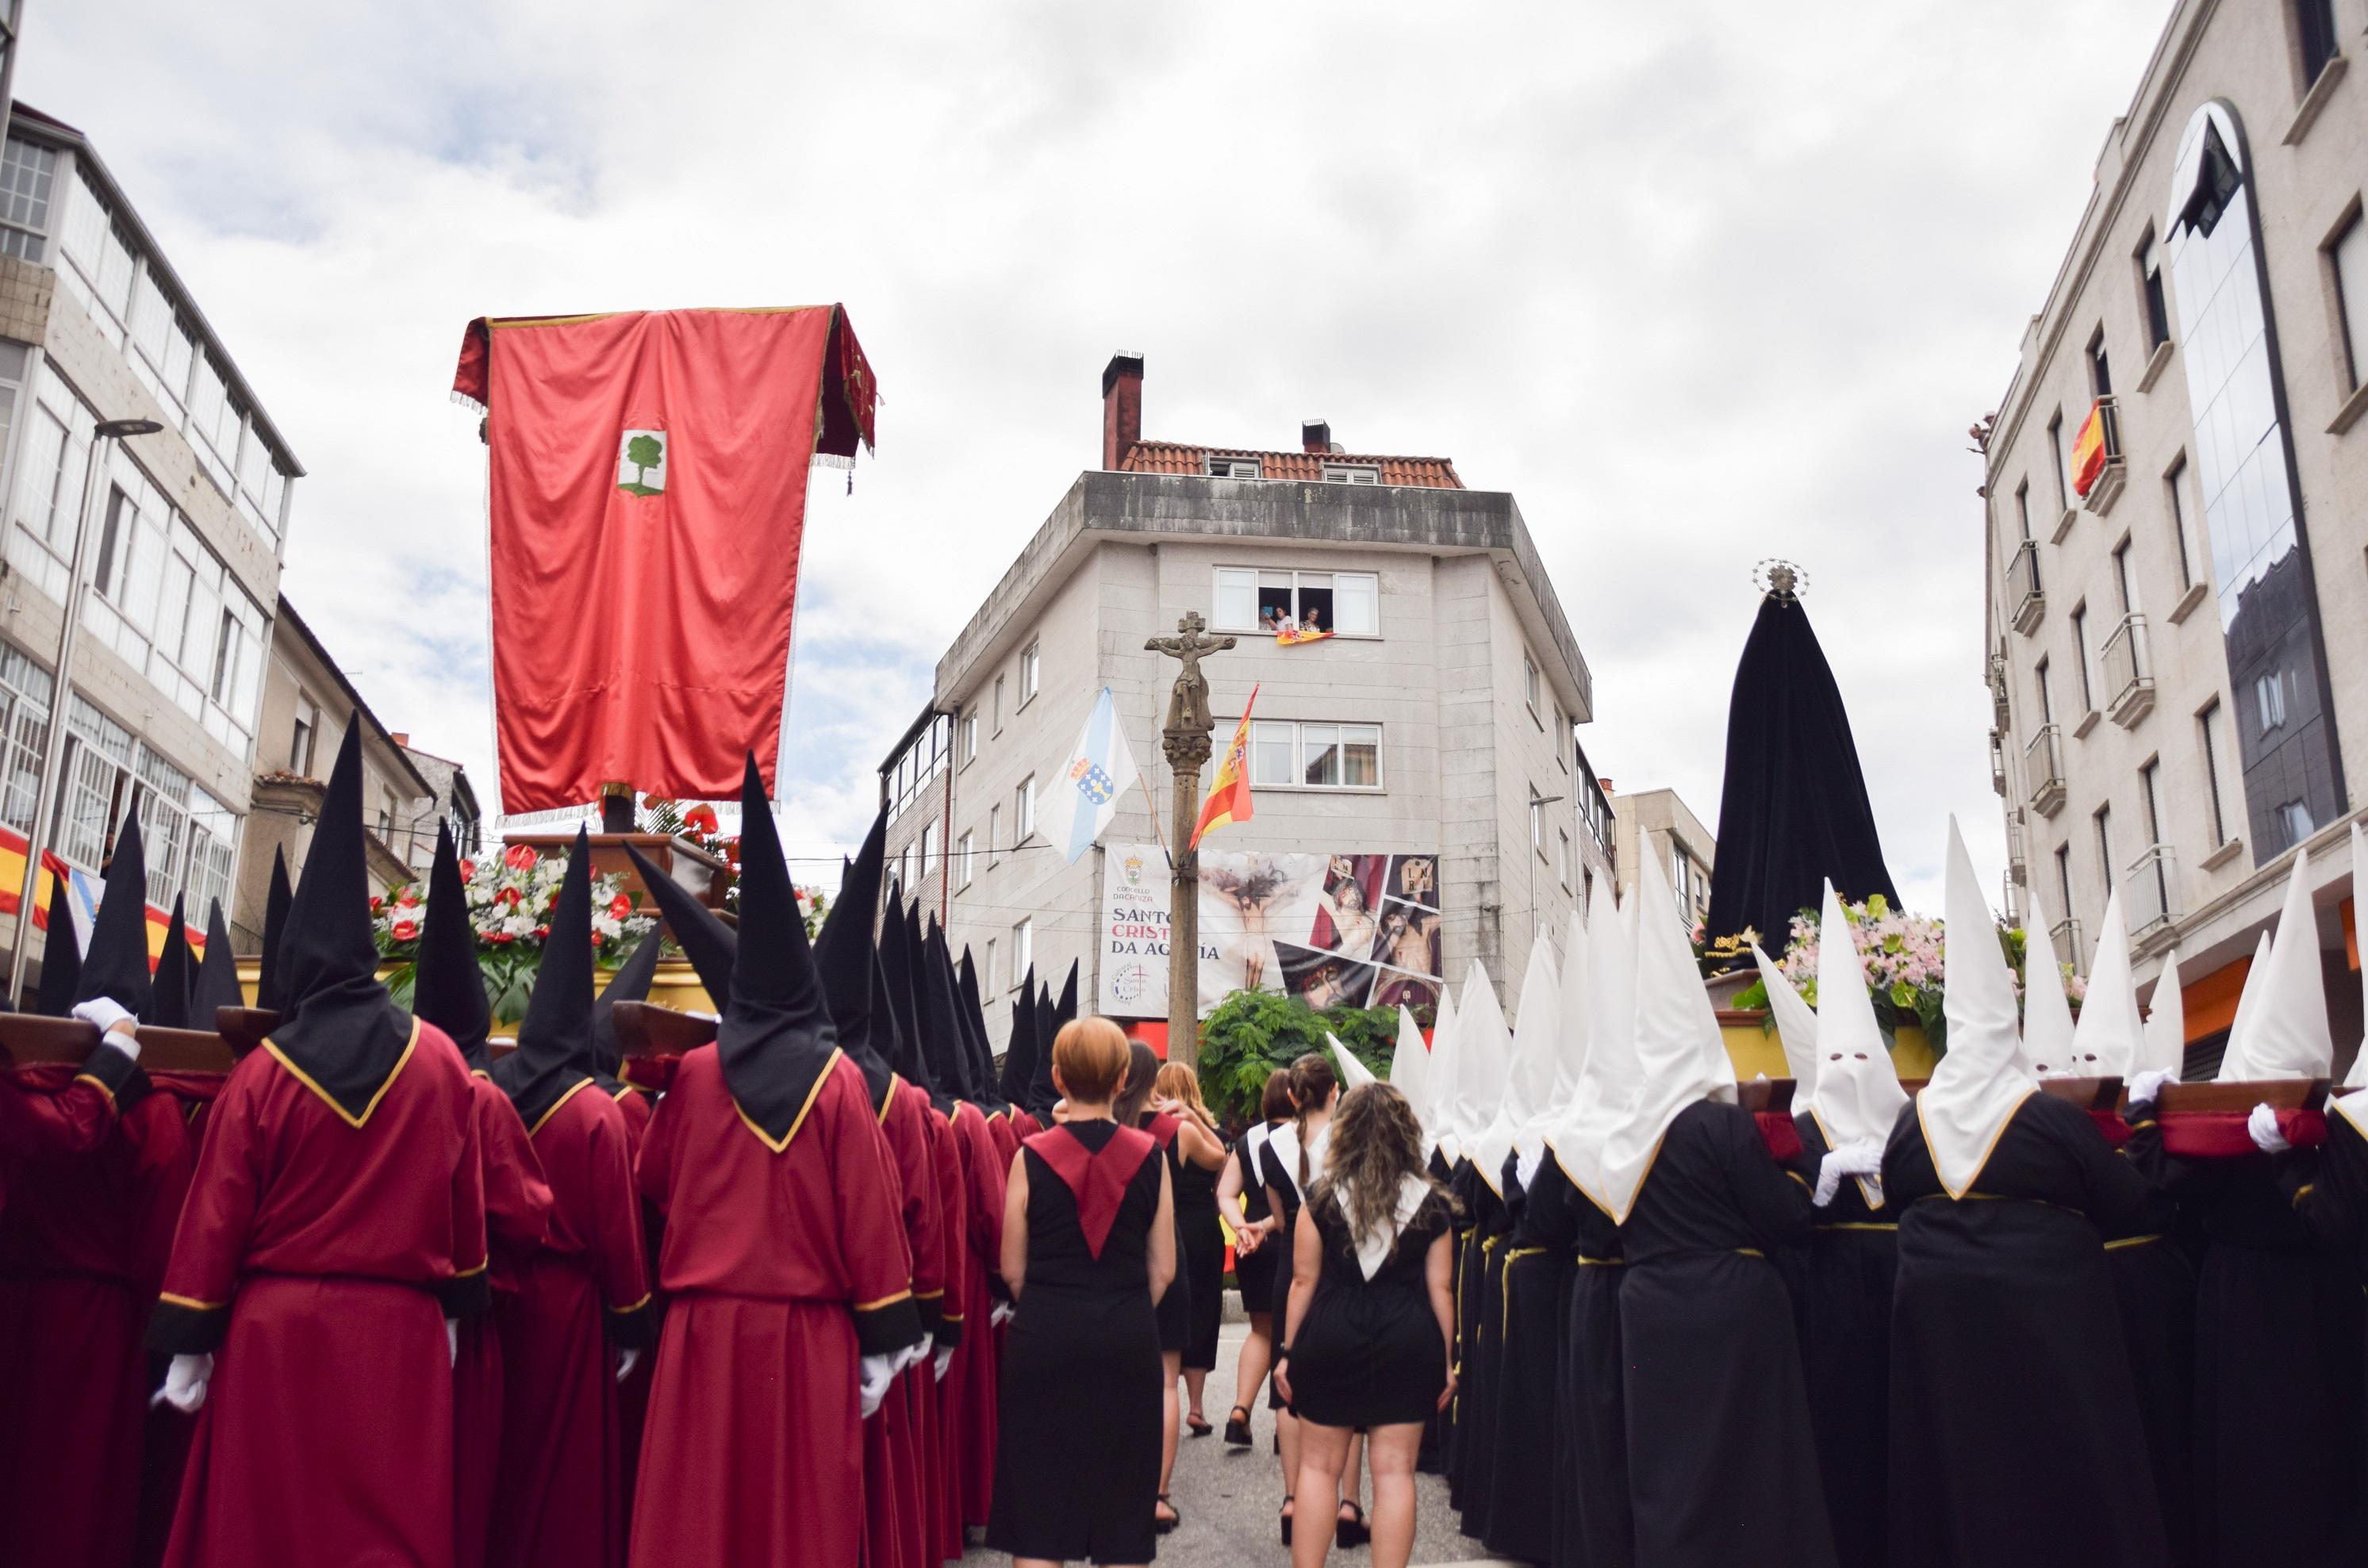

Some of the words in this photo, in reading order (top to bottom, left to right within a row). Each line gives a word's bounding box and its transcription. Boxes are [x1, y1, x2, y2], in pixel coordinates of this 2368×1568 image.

[1111, 924, 1171, 941] CRIST
[1111, 941, 1138, 954] DA
[1144, 942, 1220, 960] AGÍA
